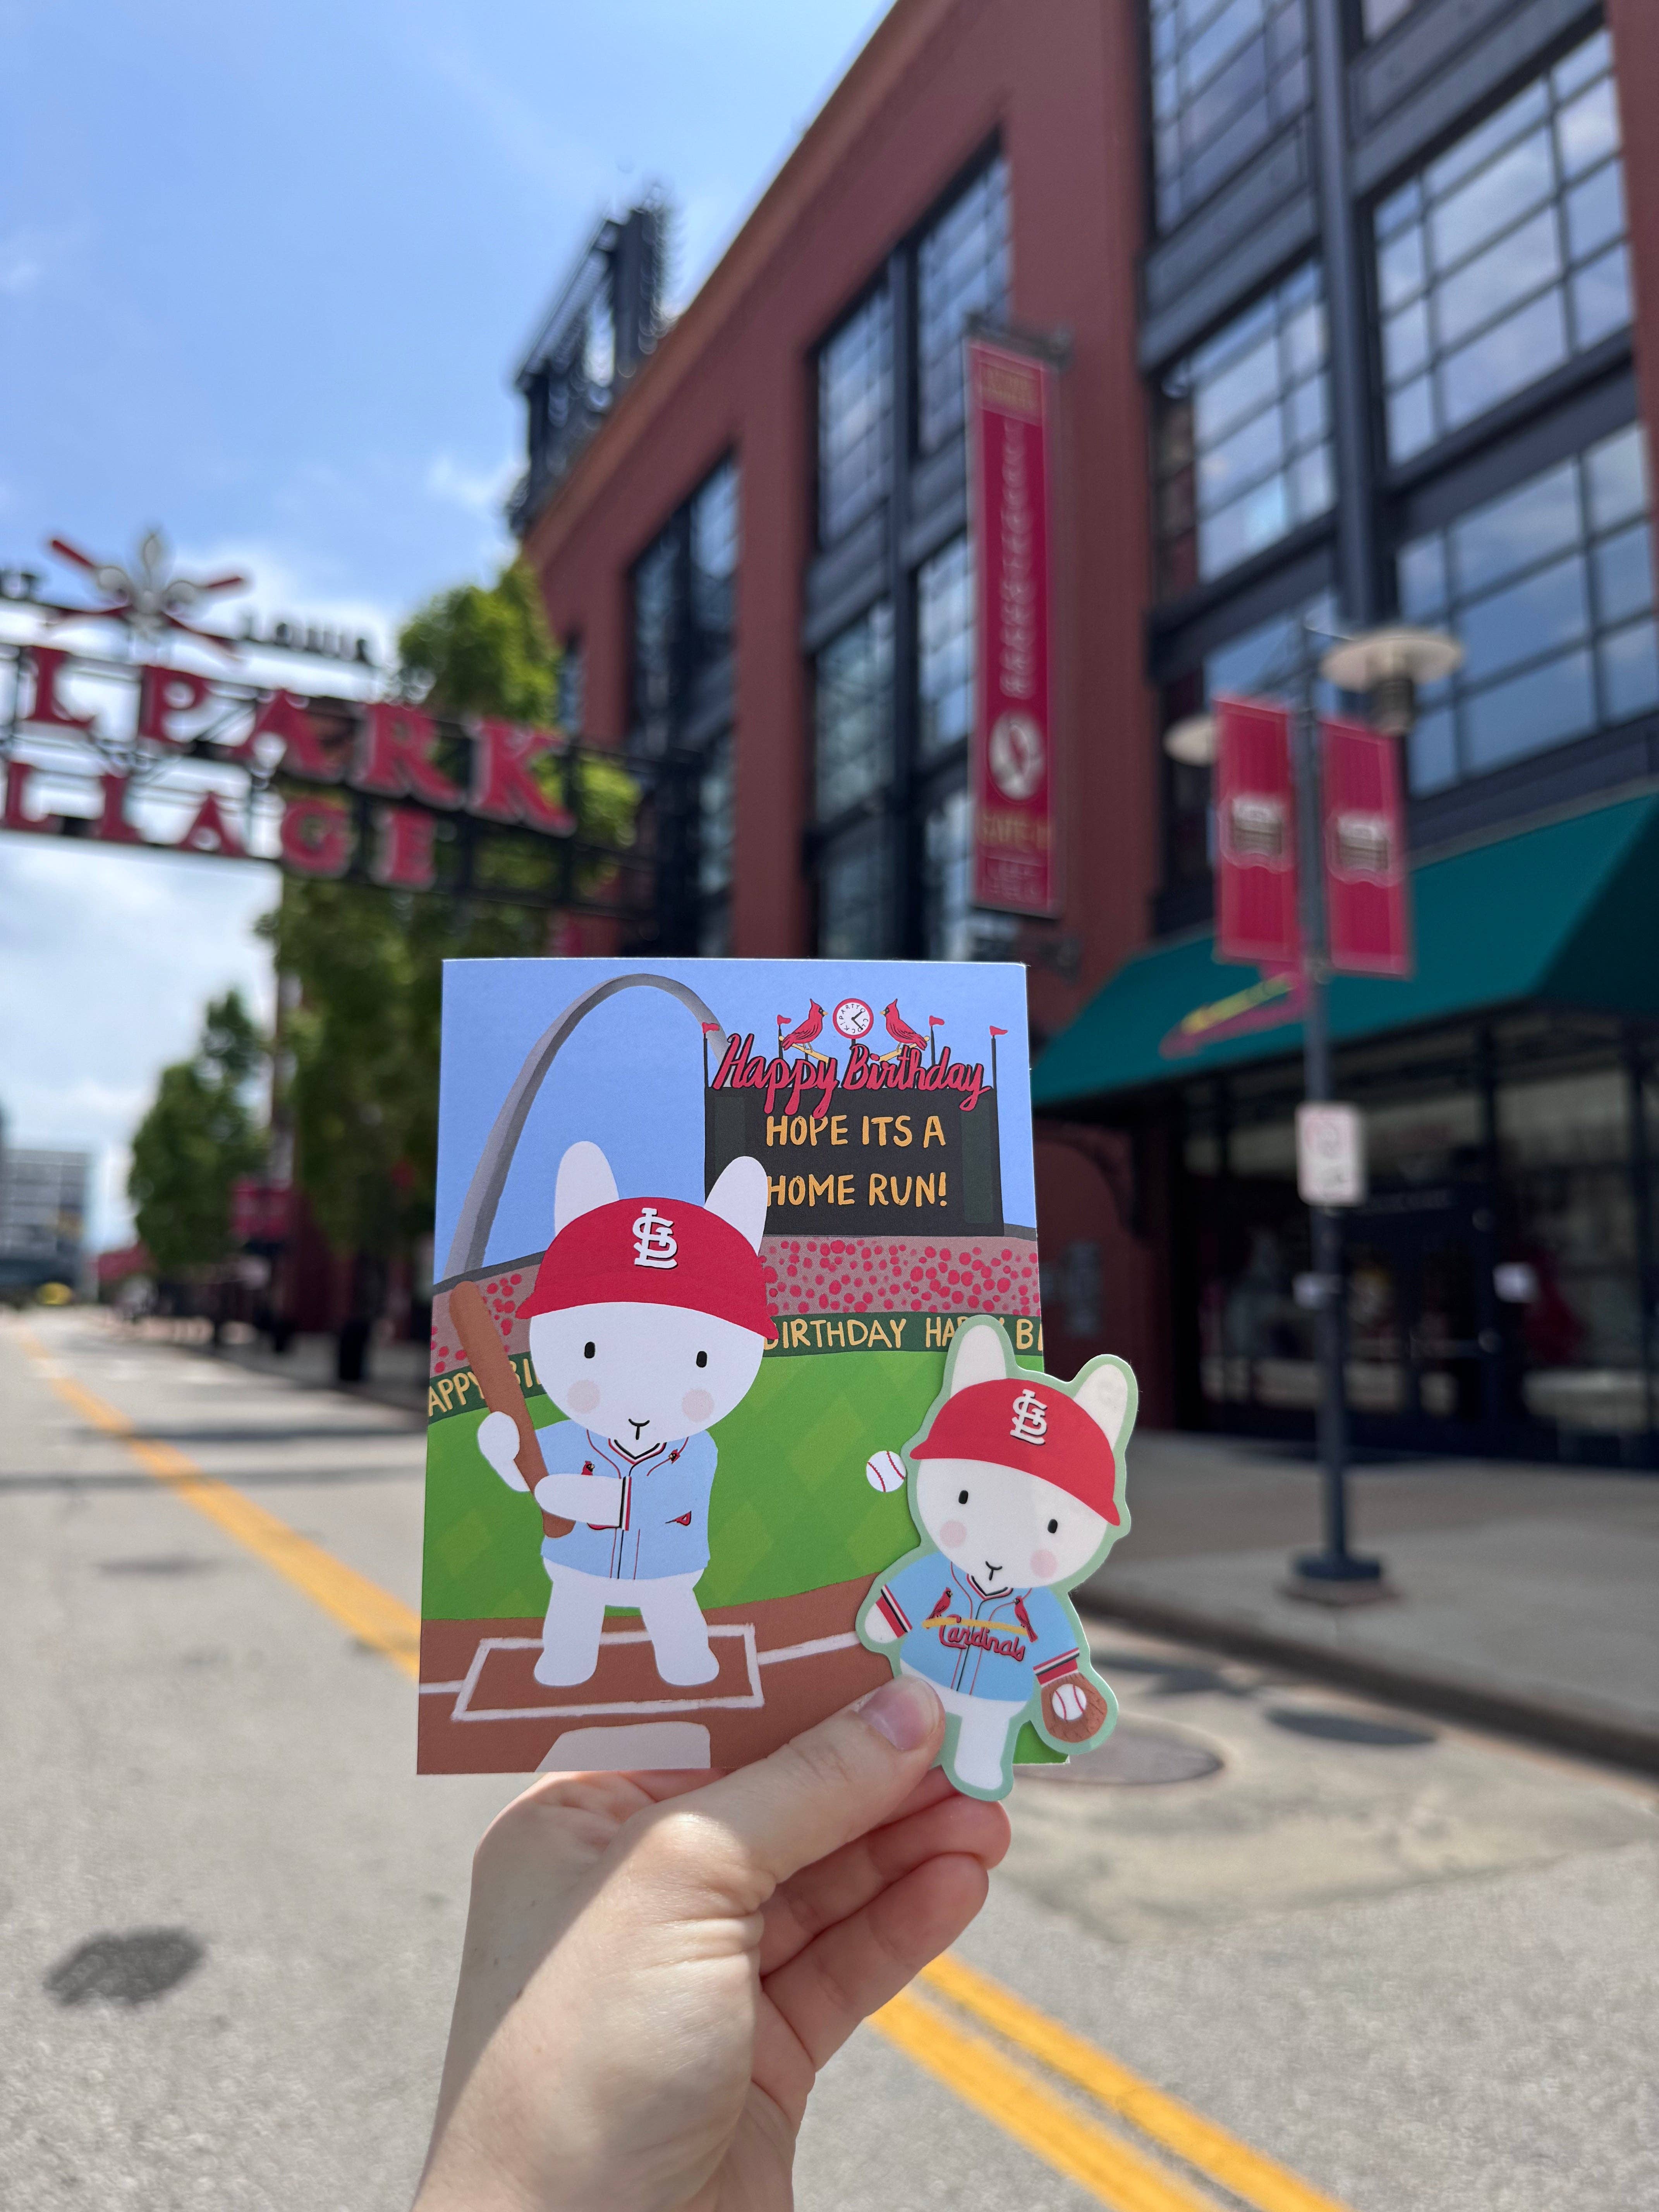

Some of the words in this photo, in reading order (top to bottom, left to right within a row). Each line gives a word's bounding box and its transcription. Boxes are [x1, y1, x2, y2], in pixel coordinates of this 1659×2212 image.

[839, 1004, 860, 1020] PARTY
[712, 1032, 839, 1119] Happy
[841, 1043, 990, 1111] Birthday
[766, 1115, 848, 1147] HOPE
[862, 1115, 912, 1147] ITS
[923, 1116, 946, 1148] A
[767, 1174, 855, 1207] HOME
[869, 1172, 947, 1207] RUN!
[938, 1613, 1026, 1662] Cardinals
